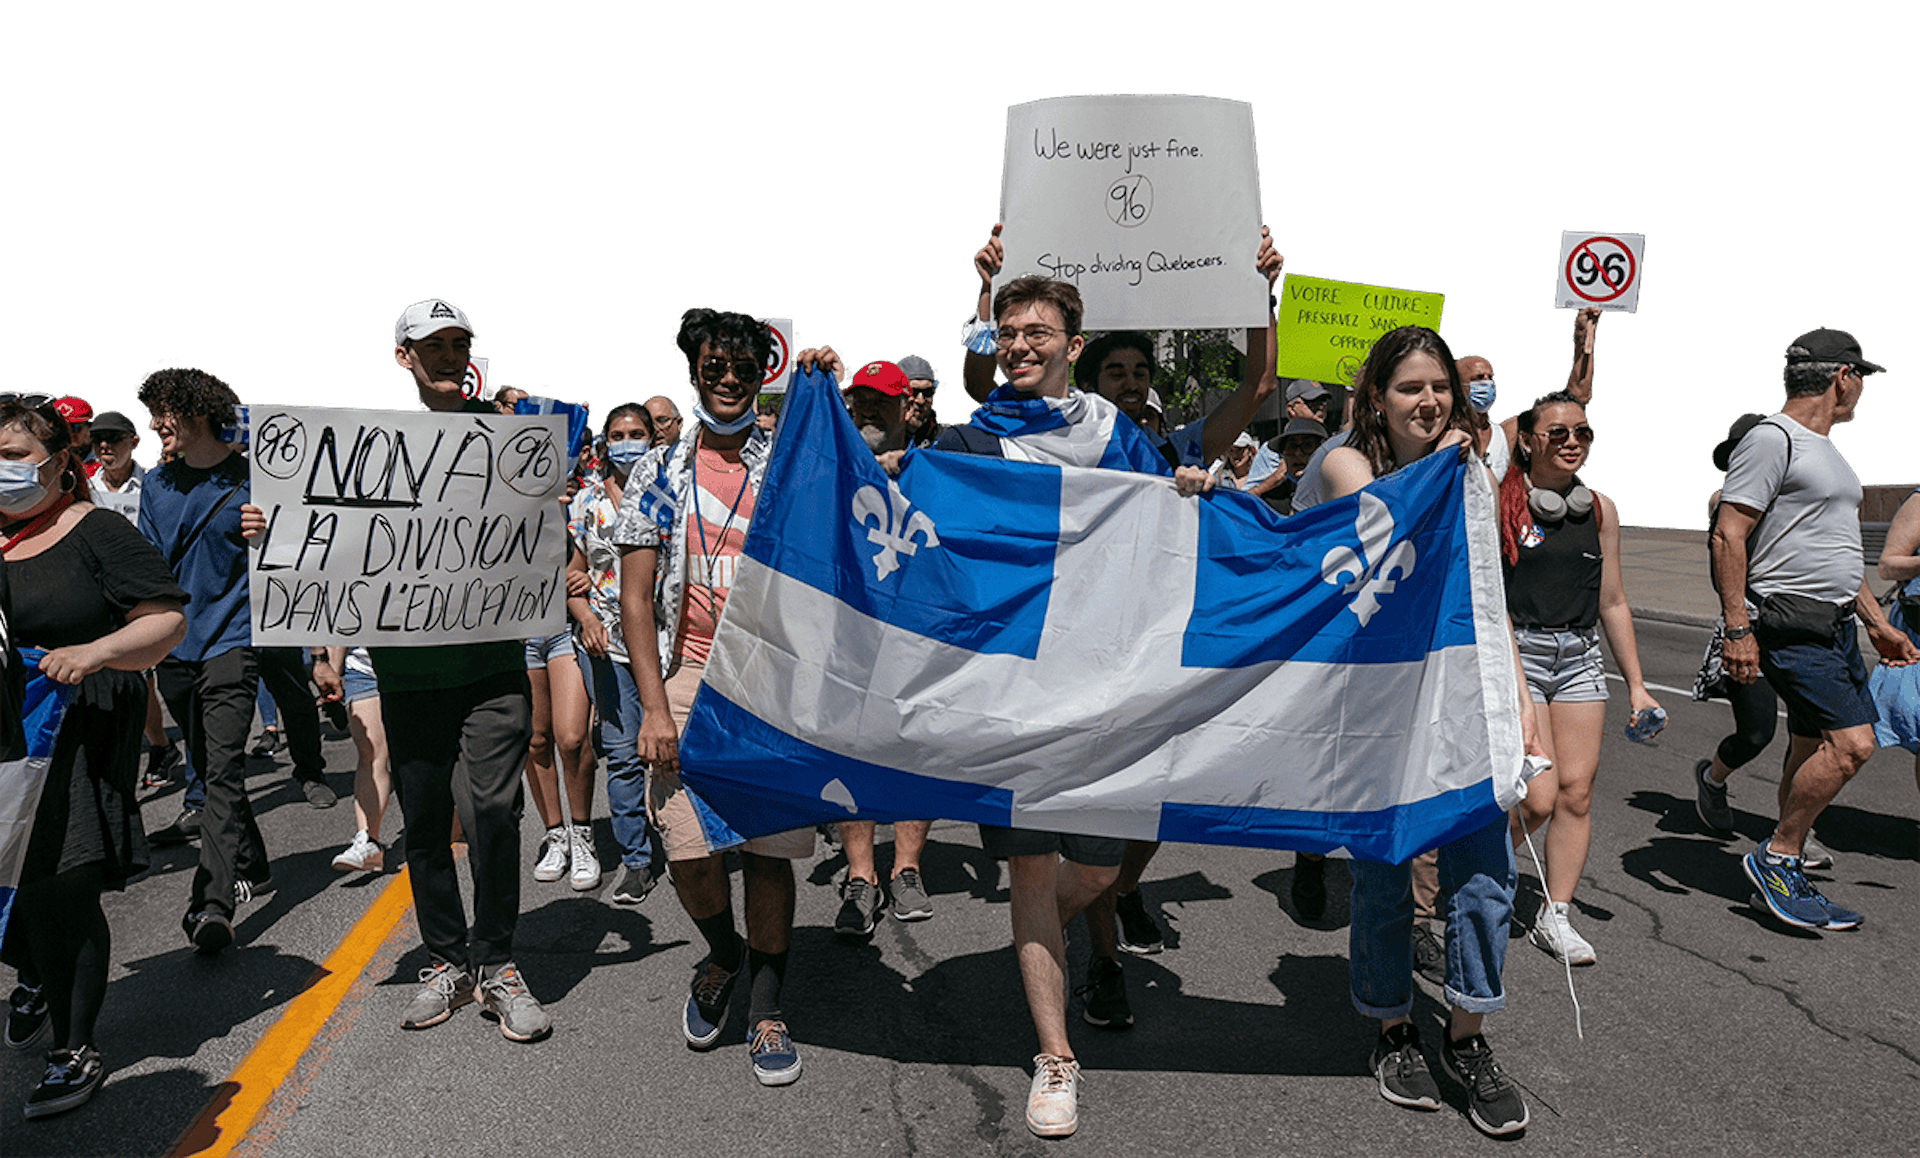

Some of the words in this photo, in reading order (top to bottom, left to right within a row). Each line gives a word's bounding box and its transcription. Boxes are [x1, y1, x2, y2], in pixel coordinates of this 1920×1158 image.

[1034, 127, 1071, 160] We
[1077, 142, 1122, 160] were
[1125, 142, 1161, 174] just
[1166, 138, 1203, 158] fine.
[1110, 185, 1146, 221] 96
[1037, 253, 1086, 286] Stop
[1146, 251, 1227, 274] Quebecers.
[1575, 252, 1626, 287] 96
[1290, 285, 1341, 305] VOTRE
[262, 424, 298, 465] 96
[303, 425, 446, 503] NON
[438, 417, 495, 509] À
[515, 435, 553, 479] 96
[256, 504, 338, 571] LA
[361, 507, 544, 577] DIVISION
[260, 576, 370, 636] DANS
[376, 565, 560, 633] L'ÉDUCATION
